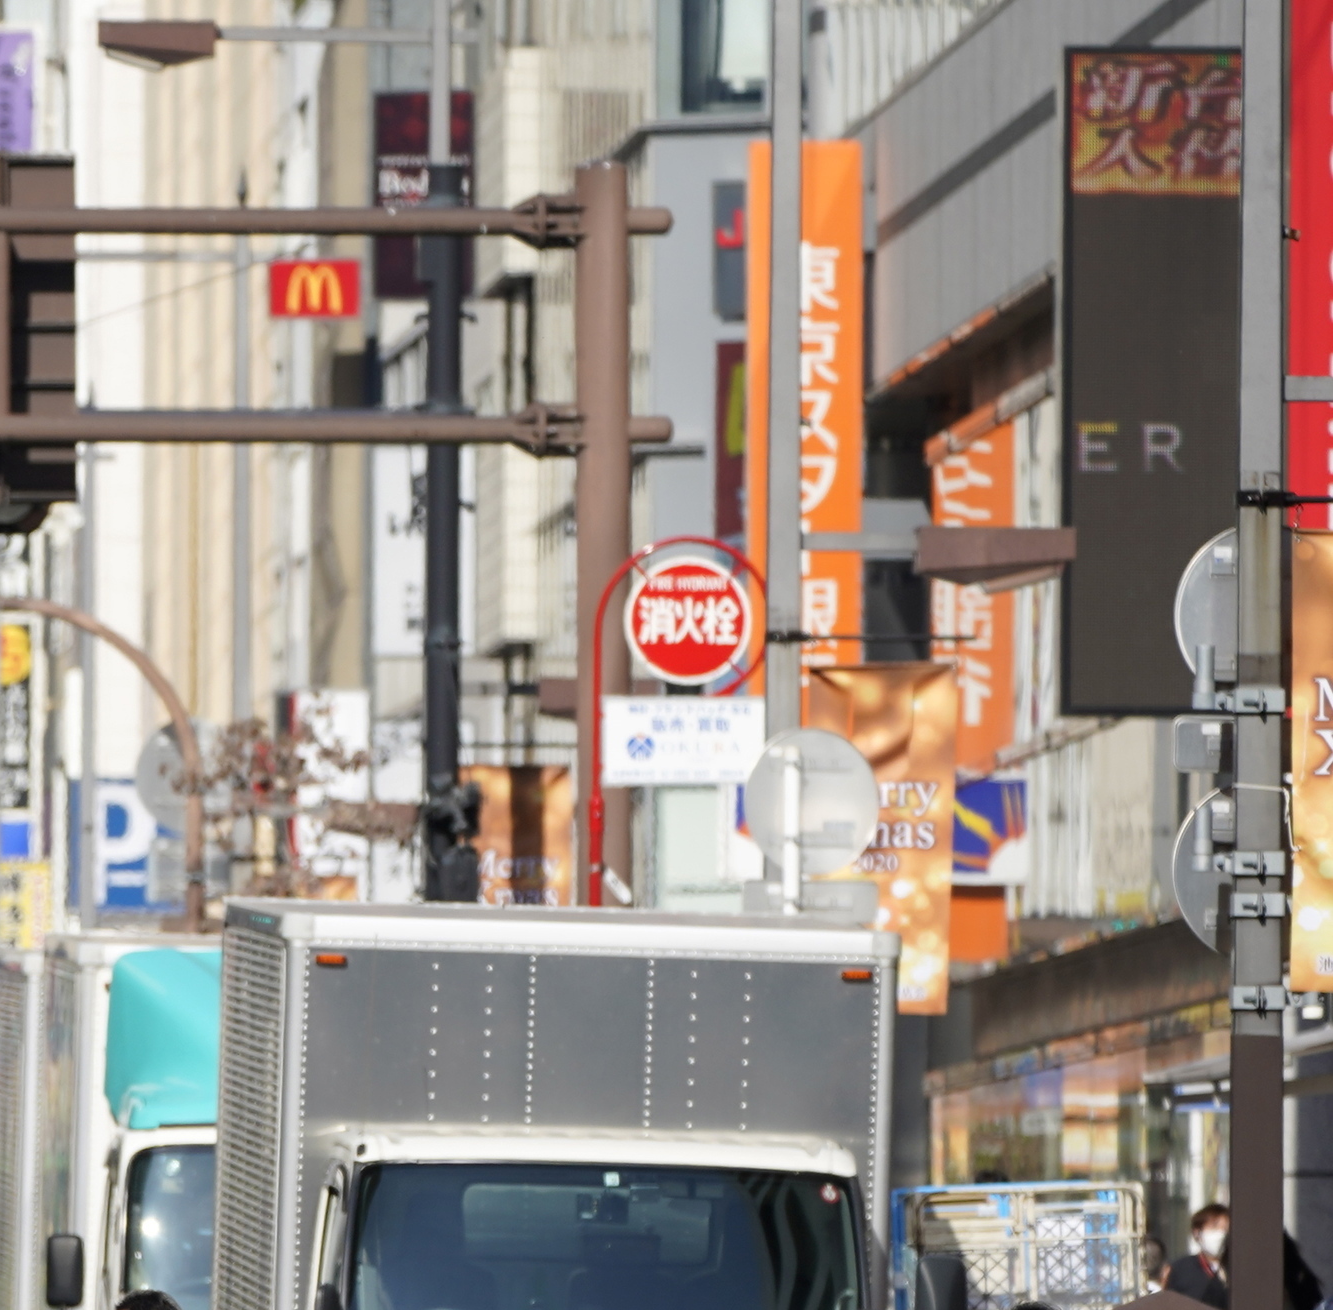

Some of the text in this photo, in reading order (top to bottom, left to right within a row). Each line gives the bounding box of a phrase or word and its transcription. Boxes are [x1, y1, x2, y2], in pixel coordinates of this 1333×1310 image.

[648, 575, 728, 591] FIRE HYDRANT
[638, 596, 739, 646] 消火栓
[879, 781, 938, 816] rry
[851, 854, 899, 873] 2020
